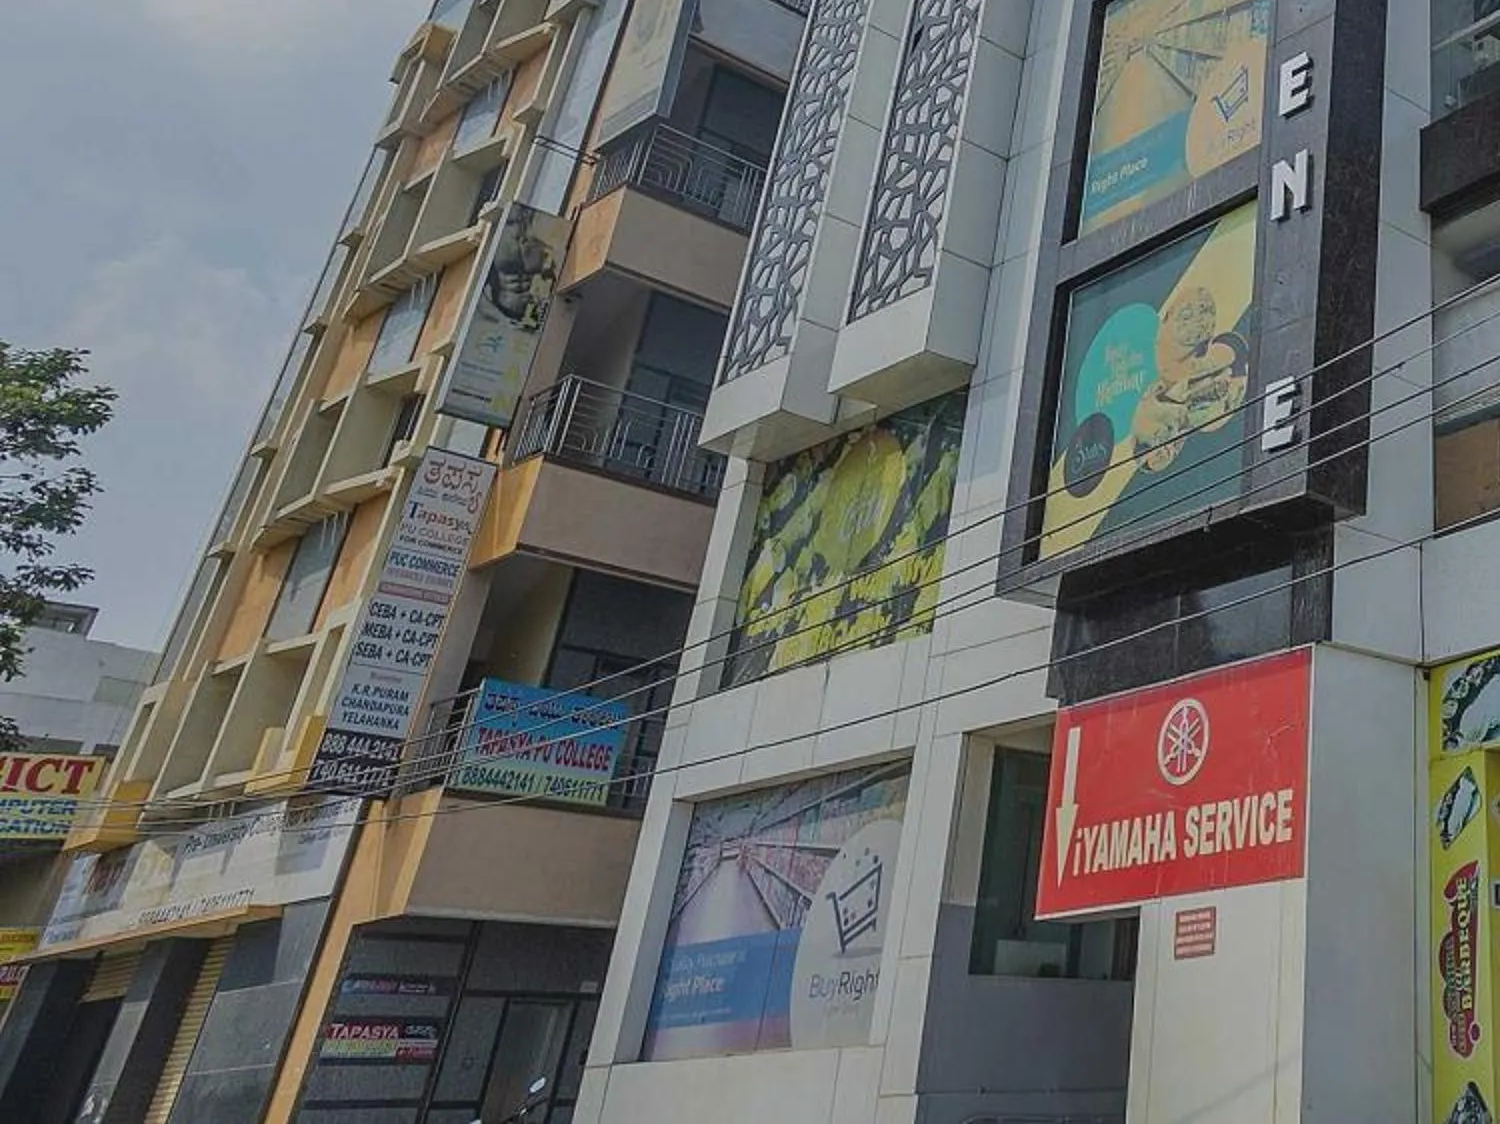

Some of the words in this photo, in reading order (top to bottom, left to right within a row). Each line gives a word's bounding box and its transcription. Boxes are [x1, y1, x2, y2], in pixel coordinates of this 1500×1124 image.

[554, 737, 613, 771] COLLEGE
[1184, 789, 1293, 859] SERVICE
[330, 1023, 399, 1041] TAPASYA
